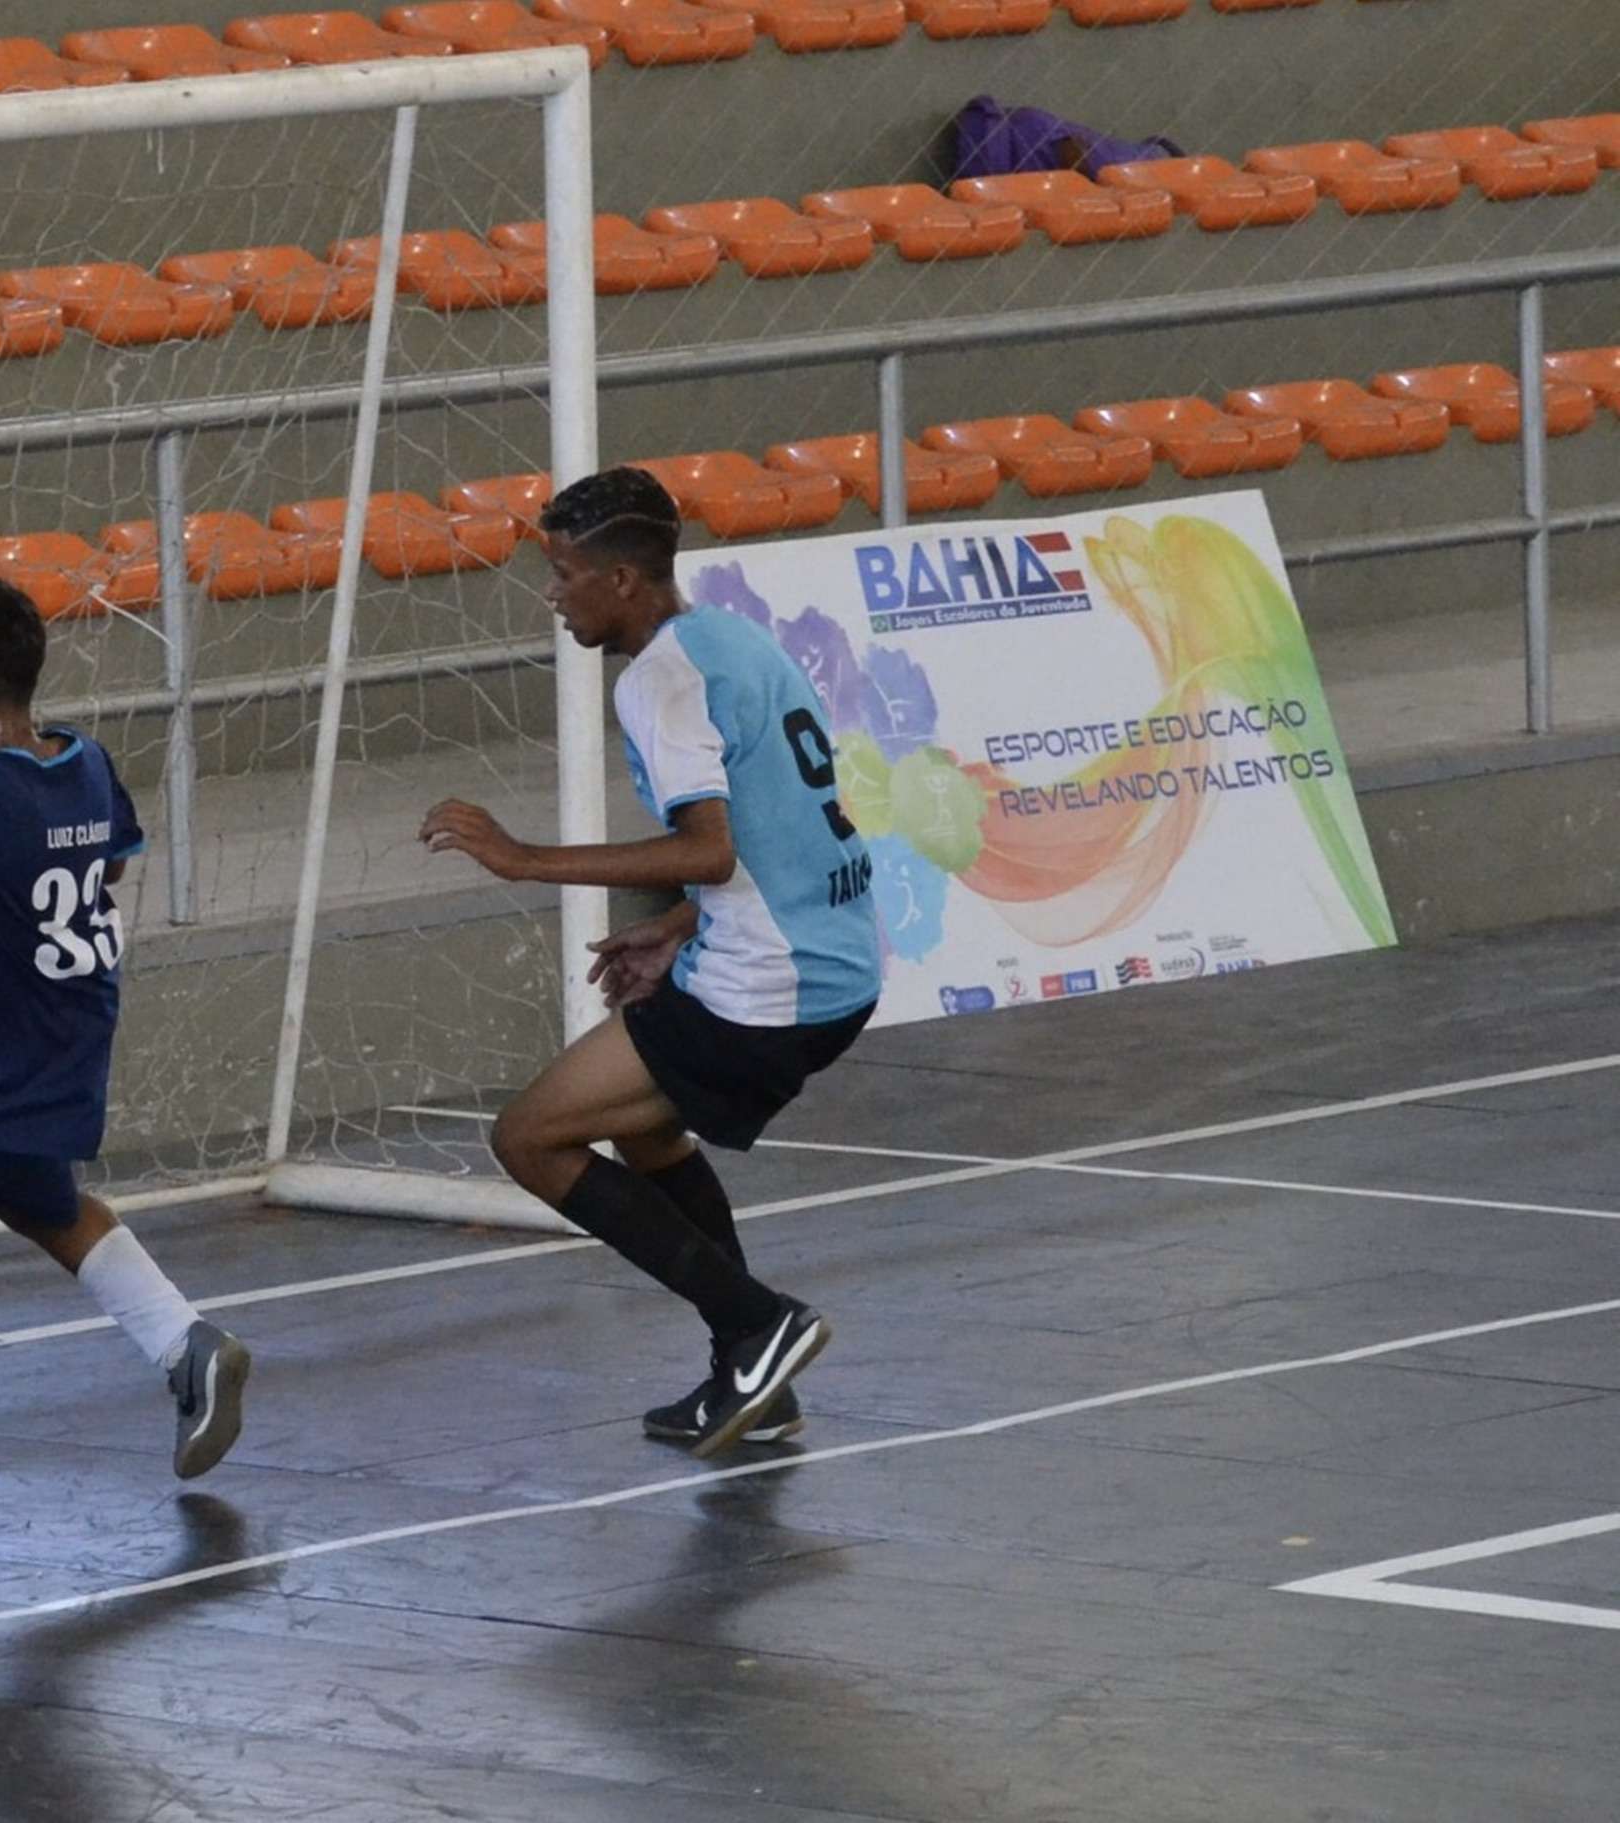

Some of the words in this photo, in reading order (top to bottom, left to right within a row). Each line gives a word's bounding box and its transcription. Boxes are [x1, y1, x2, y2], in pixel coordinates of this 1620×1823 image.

[854, 536, 1062, 613] BAHIA
[934, 608, 998, 625] Escolares
[1020, 597, 1088, 616] Juventude
[984, 722, 1121, 766] ESPORTE
[1124, 720, 1144, 748] E
[1148, 698, 1308, 744] EDUCAÇÃO
[782, 706, 857, 842] 9
[998, 768, 1180, 819] REVELANDO
[1182, 749, 1335, 795] TALENTOS
[47, 827, 74, 849] LUIZ
[31, 857, 125, 980] 33
